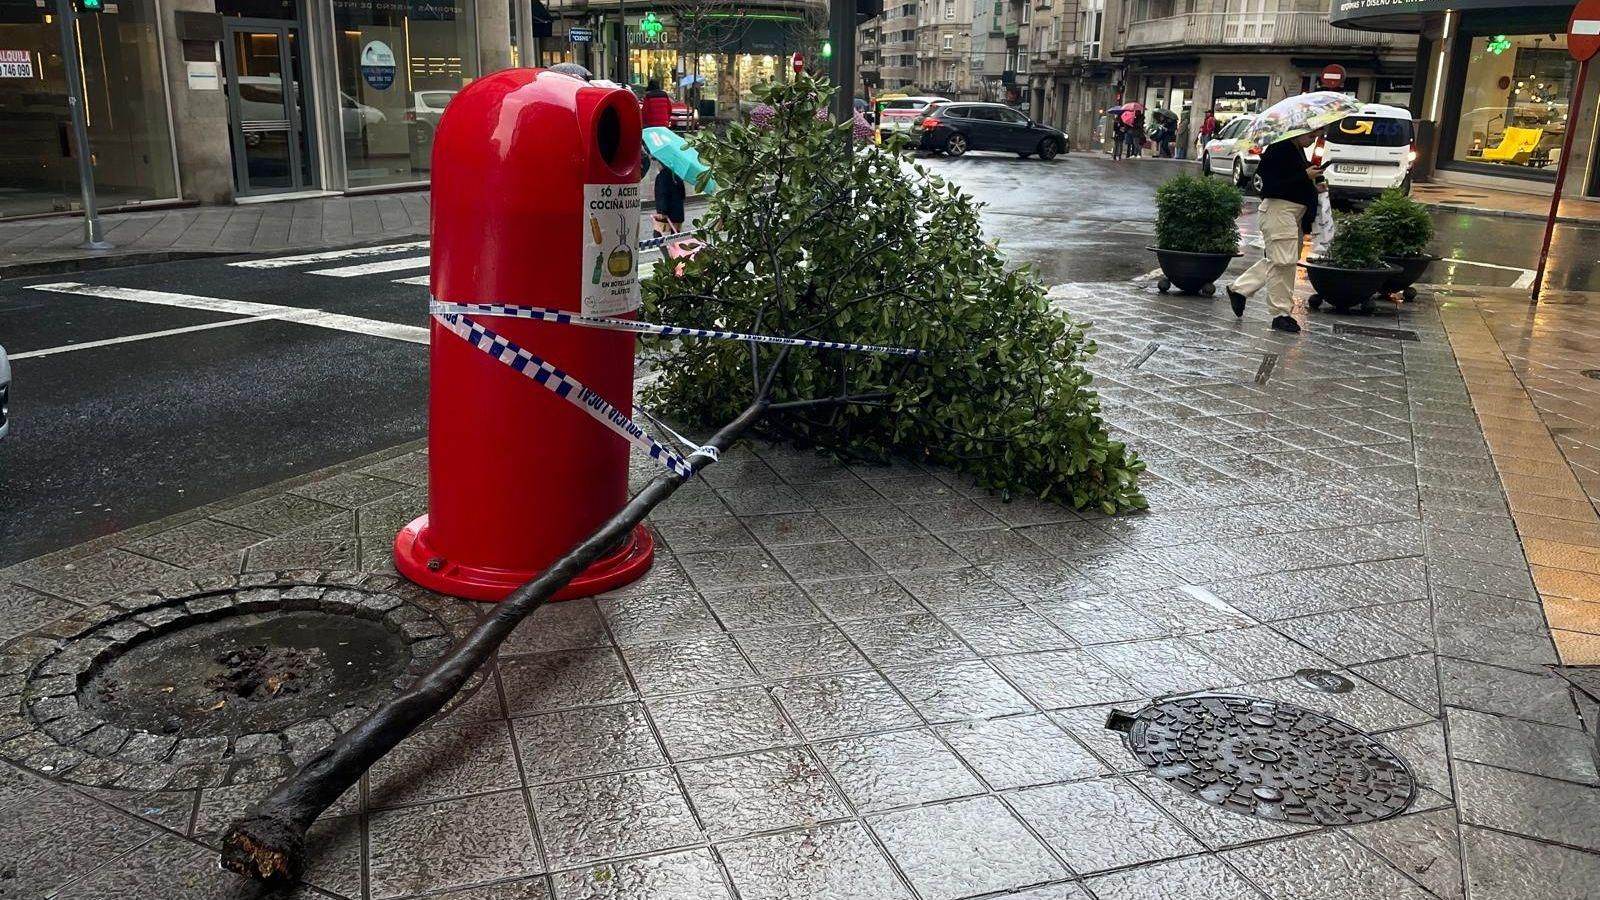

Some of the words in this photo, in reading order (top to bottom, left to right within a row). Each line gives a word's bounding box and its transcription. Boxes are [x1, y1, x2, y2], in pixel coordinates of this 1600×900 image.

[601, 186, 612, 197] SÓ
[617, 187, 638, 197] ACEITE
[590, 198, 624, 210] COCIÑA
